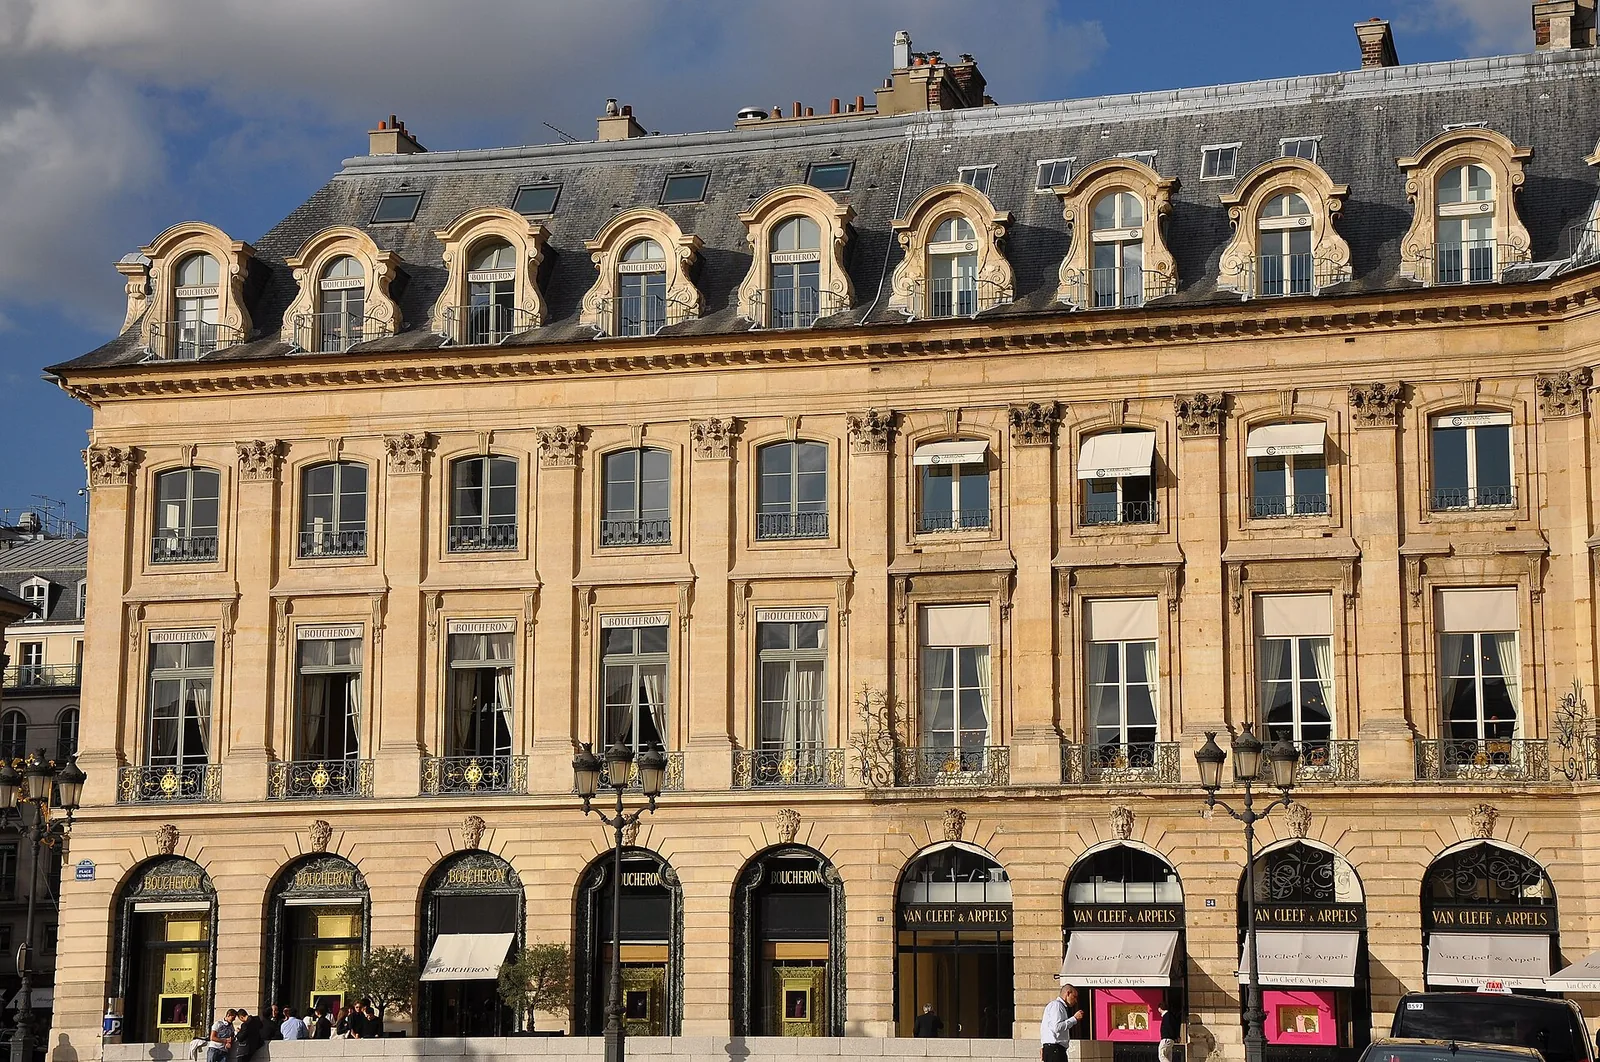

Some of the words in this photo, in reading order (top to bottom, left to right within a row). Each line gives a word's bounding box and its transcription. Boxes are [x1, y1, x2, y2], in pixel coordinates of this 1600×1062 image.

[774, 252, 816, 262] BOUCHERON
[621, 262, 662, 271] BOUCHERON
[470, 272, 512, 280] BOUCHERON
[323, 280, 362, 288] BOUCHERON
[178, 288, 217, 296] BOUCHERON
[609, 616, 661, 626] BOUCHERON
[764, 612, 818, 620] BOUCHERON
[456, 623, 507, 632] BOUCHERON
[158, 632, 208, 641] BOUCHERON
[304, 629, 355, 638] BOUCHERON
[296, 872, 352, 886] BOUCHERON
[449, 868, 505, 883] BOUCHERON
[770, 870, 821, 884] BOUCHERON
[144, 875, 199, 890] BOUCHERON
[903, 910, 922, 922] VAN
[926, 909, 955, 922] CLEEF
[958, 913, 965, 922] &
[968, 909, 1007, 922] ARPELS
[1073, 910, 1092, 922] VAN
[1098, 910, 1127, 922] CLEEF
[1137, 910, 1176, 922] ARPELS
[1254, 909, 1270, 921] AN
[1274, 909, 1306, 922] CLEEF
[1317, 909, 1357, 922] ARPELS
[1432, 911, 1454, 924] VAN
[1459, 911, 1492, 924] CLEEF
[1496, 916, 1501, 924] &
[1505, 912, 1548, 925] ARPELS
[112, 1020, 120, 1031] P
